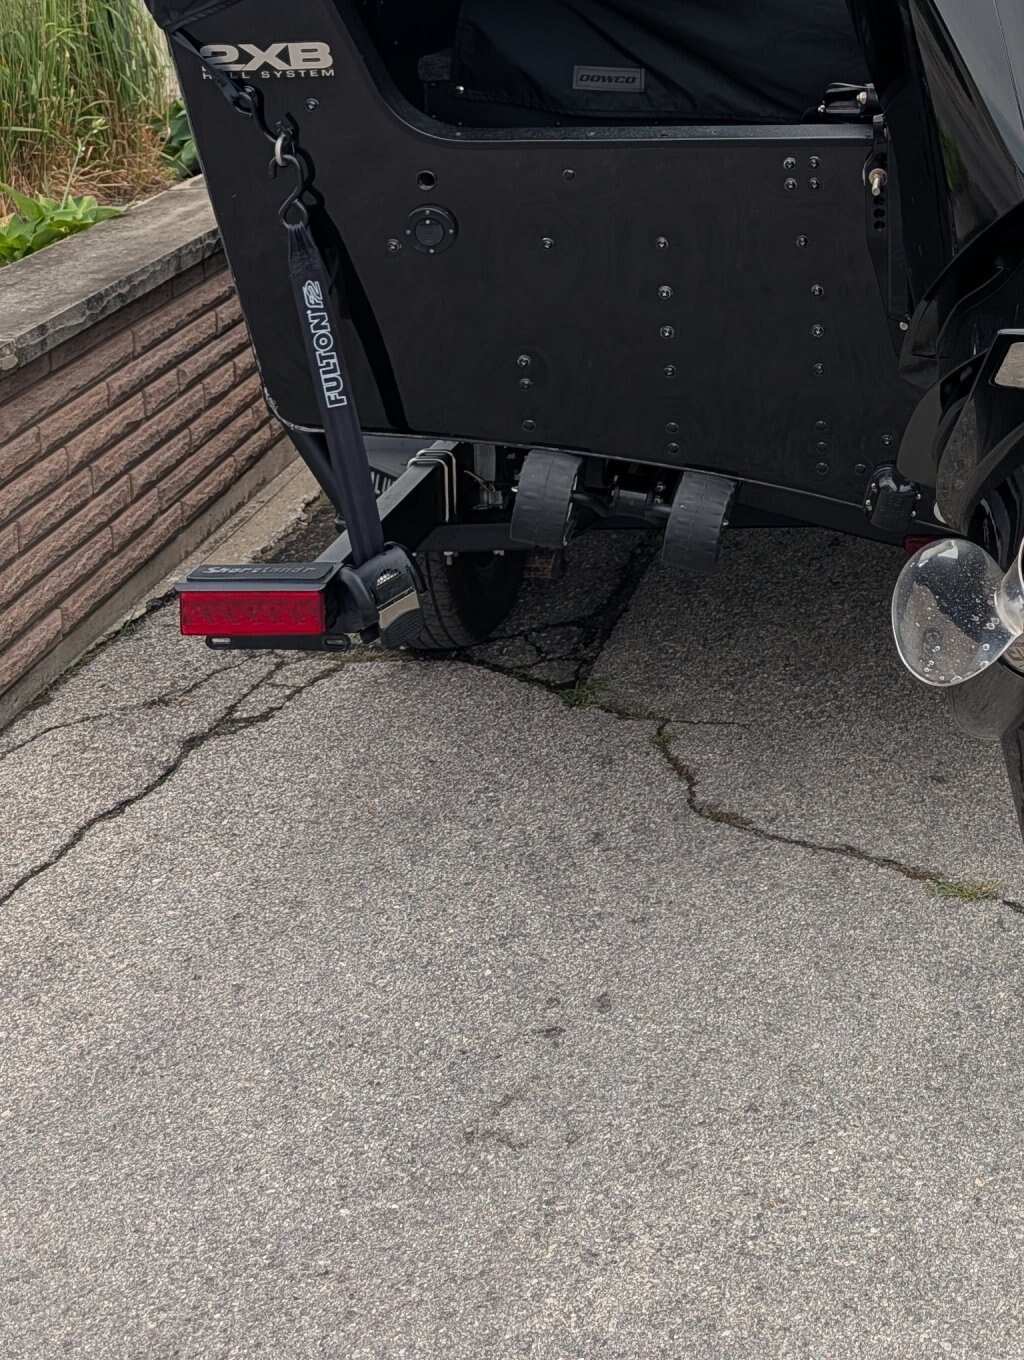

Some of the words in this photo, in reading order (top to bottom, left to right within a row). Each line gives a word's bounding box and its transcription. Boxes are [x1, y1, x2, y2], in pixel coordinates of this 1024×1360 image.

[200, 42, 333, 71] 2XB
[203, 71, 250, 79] HLL
[261, 69, 335, 78] SYSTEM
[579, 74, 637, 84] DOWCO
[308, 312, 347, 408] FULTON
